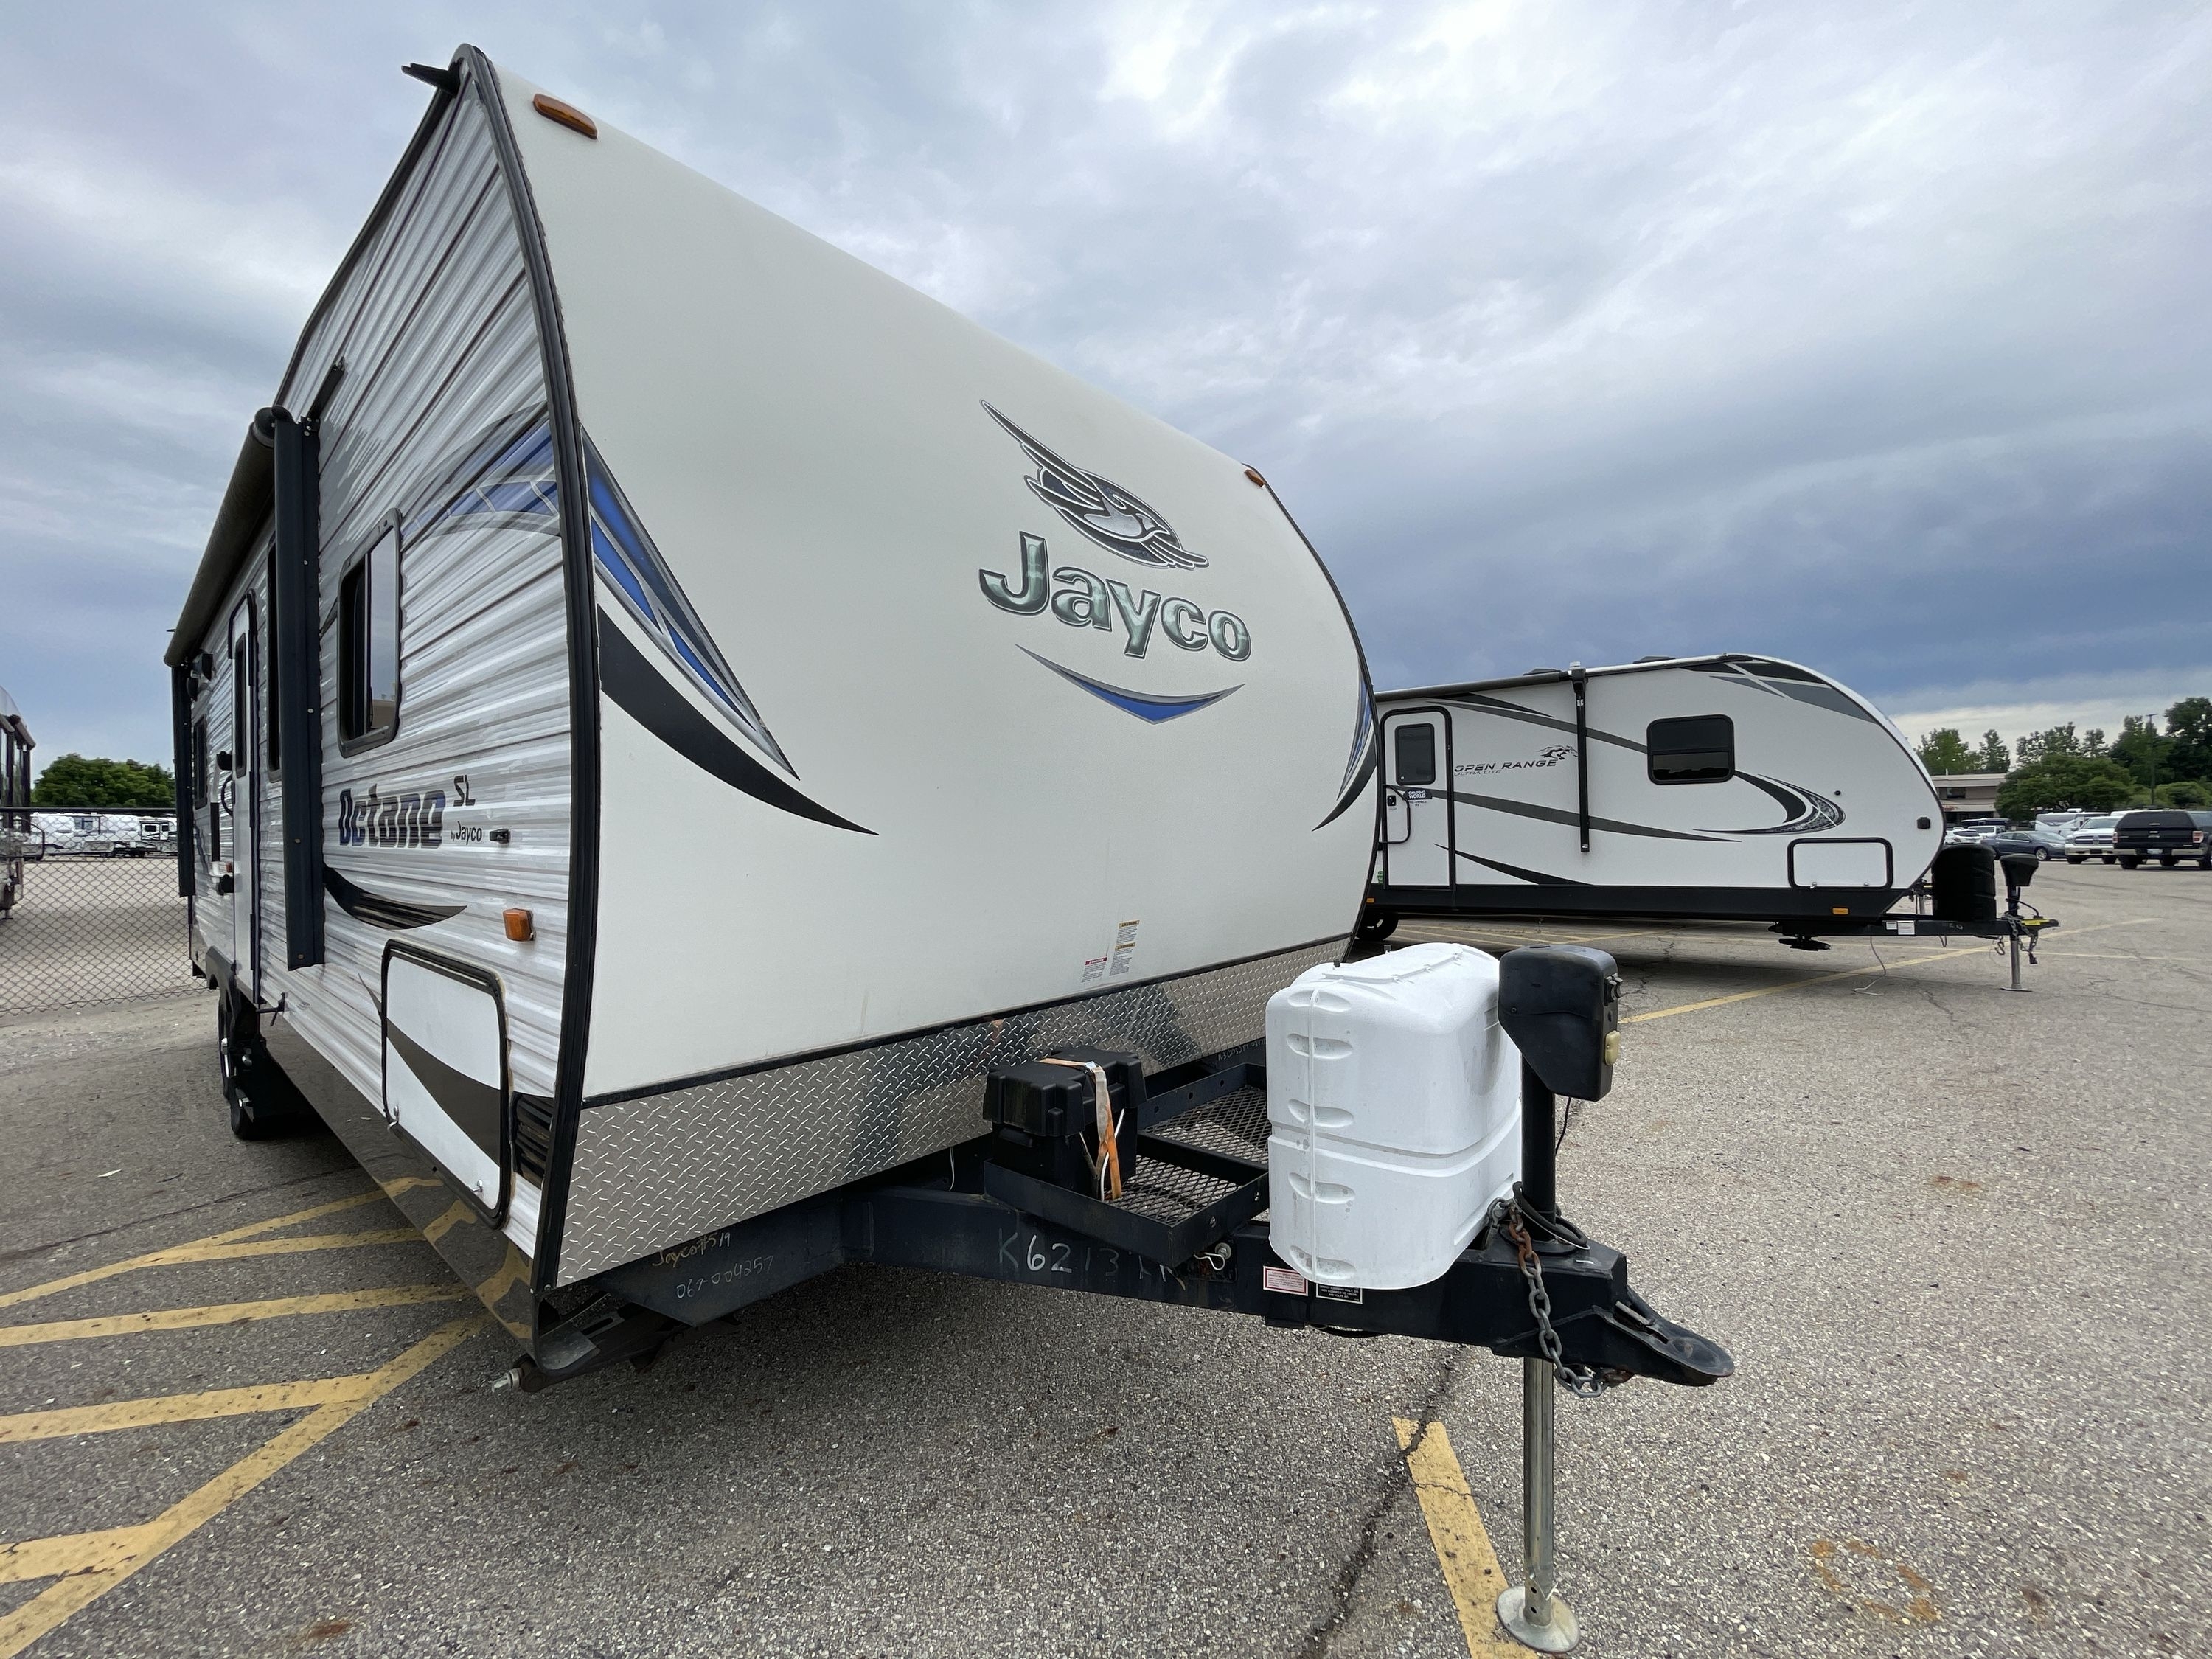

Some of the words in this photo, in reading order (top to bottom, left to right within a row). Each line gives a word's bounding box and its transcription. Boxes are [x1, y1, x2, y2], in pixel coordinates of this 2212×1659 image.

[978, 531, 1252, 661] Jayco
[1454, 762, 1496, 772] OPEN
[1501, 759, 1559, 770] RANGE
[453, 775, 476, 807] SL
[338, 783, 446, 849] Octane
[456, 821, 483, 846] Jayco
